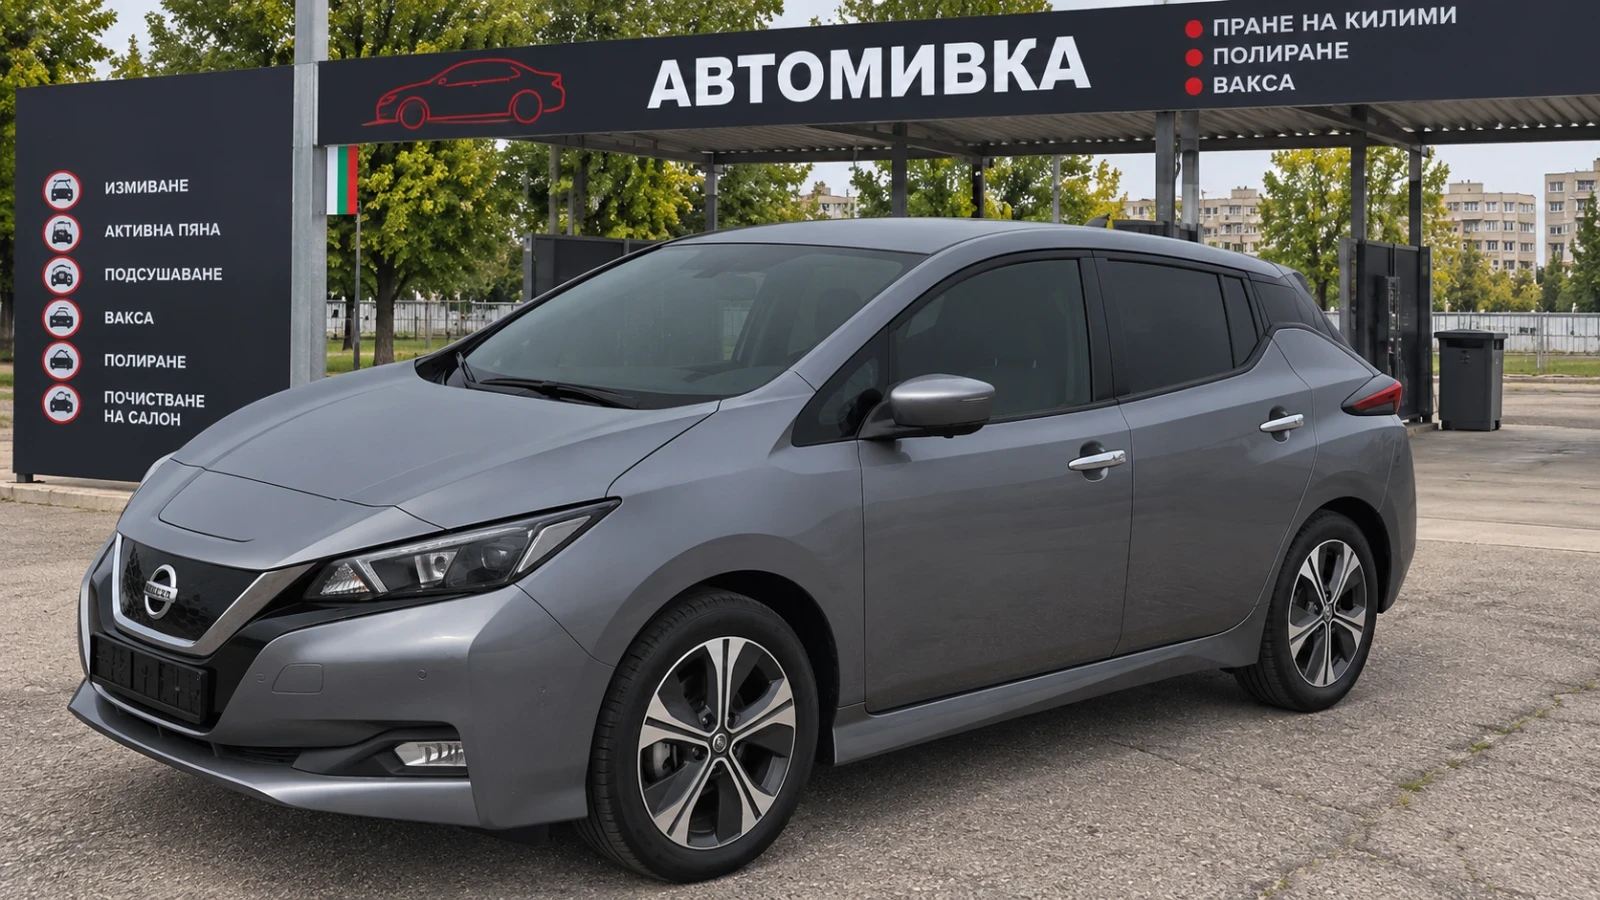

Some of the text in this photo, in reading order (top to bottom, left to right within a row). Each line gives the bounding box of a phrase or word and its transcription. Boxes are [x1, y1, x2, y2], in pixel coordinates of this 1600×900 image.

[1213, 6, 1457, 36] ПРАНЕ НА КИЛИМИ
[1213, 42, 1349, 65] ПОЛИРАНЕ
[647, 36, 1092, 109] АВТОМИВКА
[1213, 73, 1296, 94] ВАКСА
[105, 178, 189, 195] ИЗМИВАНЕ
[104, 222, 221, 238] АКТИВНА ПЯНА
[104, 267, 223, 283] ПОДСУШАВАНЕ
[104, 311, 155, 325] ВАКСА
[104, 353, 187, 369] ПОЛИРАНЕ
[104, 390, 205, 408] ПОЧИСТВАНЕ
[104, 409, 181, 427] НА САЛОН
